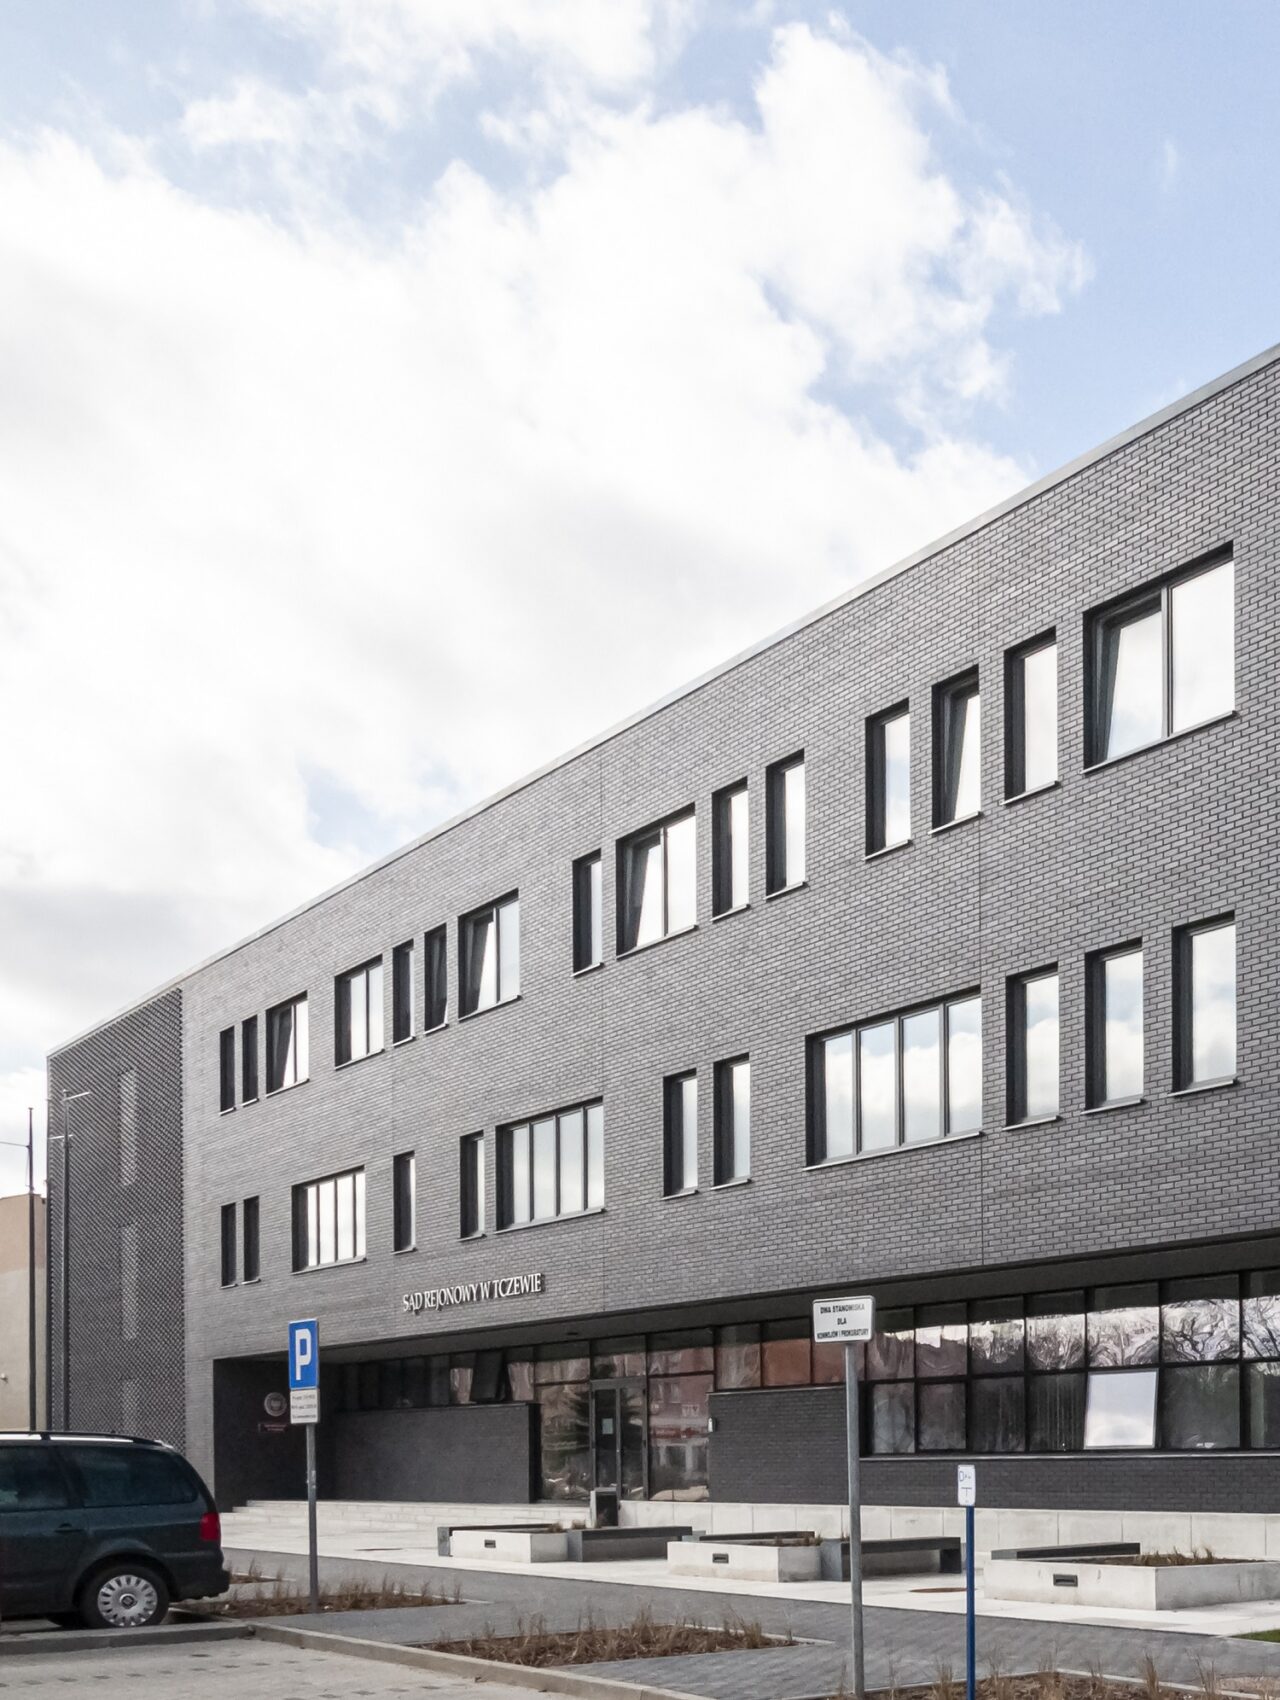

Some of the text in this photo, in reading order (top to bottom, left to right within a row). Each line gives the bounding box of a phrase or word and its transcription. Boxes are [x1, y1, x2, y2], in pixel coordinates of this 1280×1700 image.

[403, 1273, 541, 1313] SĄD REJONOWY W TCZEWIE
[833, 1303, 865, 1312] STANOWISKA
[837, 1317, 847, 1325] DLA
[295, 1328, 311, 1380] P
